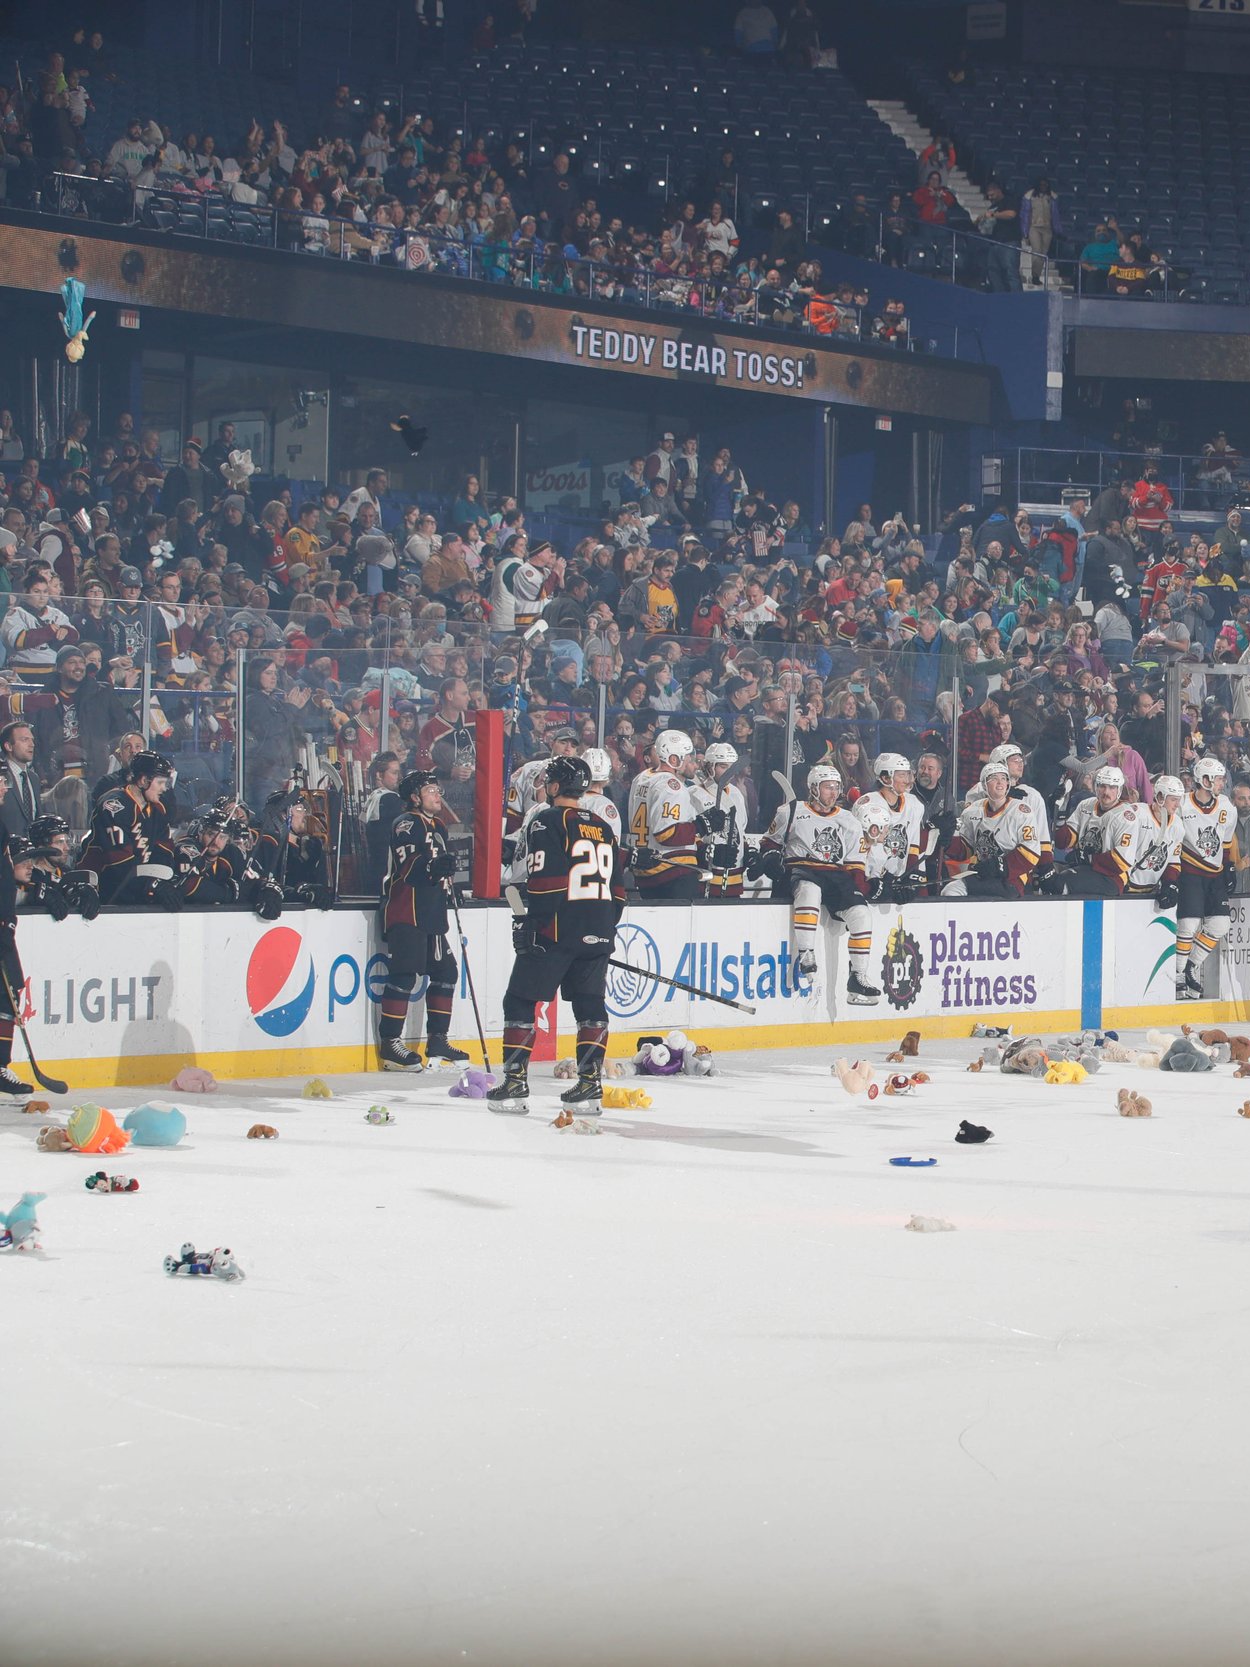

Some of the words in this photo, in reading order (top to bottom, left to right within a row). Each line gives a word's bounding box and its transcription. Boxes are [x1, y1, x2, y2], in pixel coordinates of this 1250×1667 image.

[572, 325, 656, 365] TEDDY
[663, 339, 727, 376] BEAR
[733, 349, 803, 387] TOSS!
[526, 469, 588, 493] Coors
[631, 802, 649, 847] 4
[661, 802, 681, 820] 14
[1218, 809, 1228, 824] C
[1120, 832, 1132, 847] 5
[568, 840, 613, 900] 29
[929, 918, 1021, 975] planet
[1236, 927, 1243, 944] &
[328, 936, 468, 1023] pei
[892, 954, 913, 989] pf
[941, 964, 1037, 1008] fitness
[43, 976, 161, 1024] LIGHT
